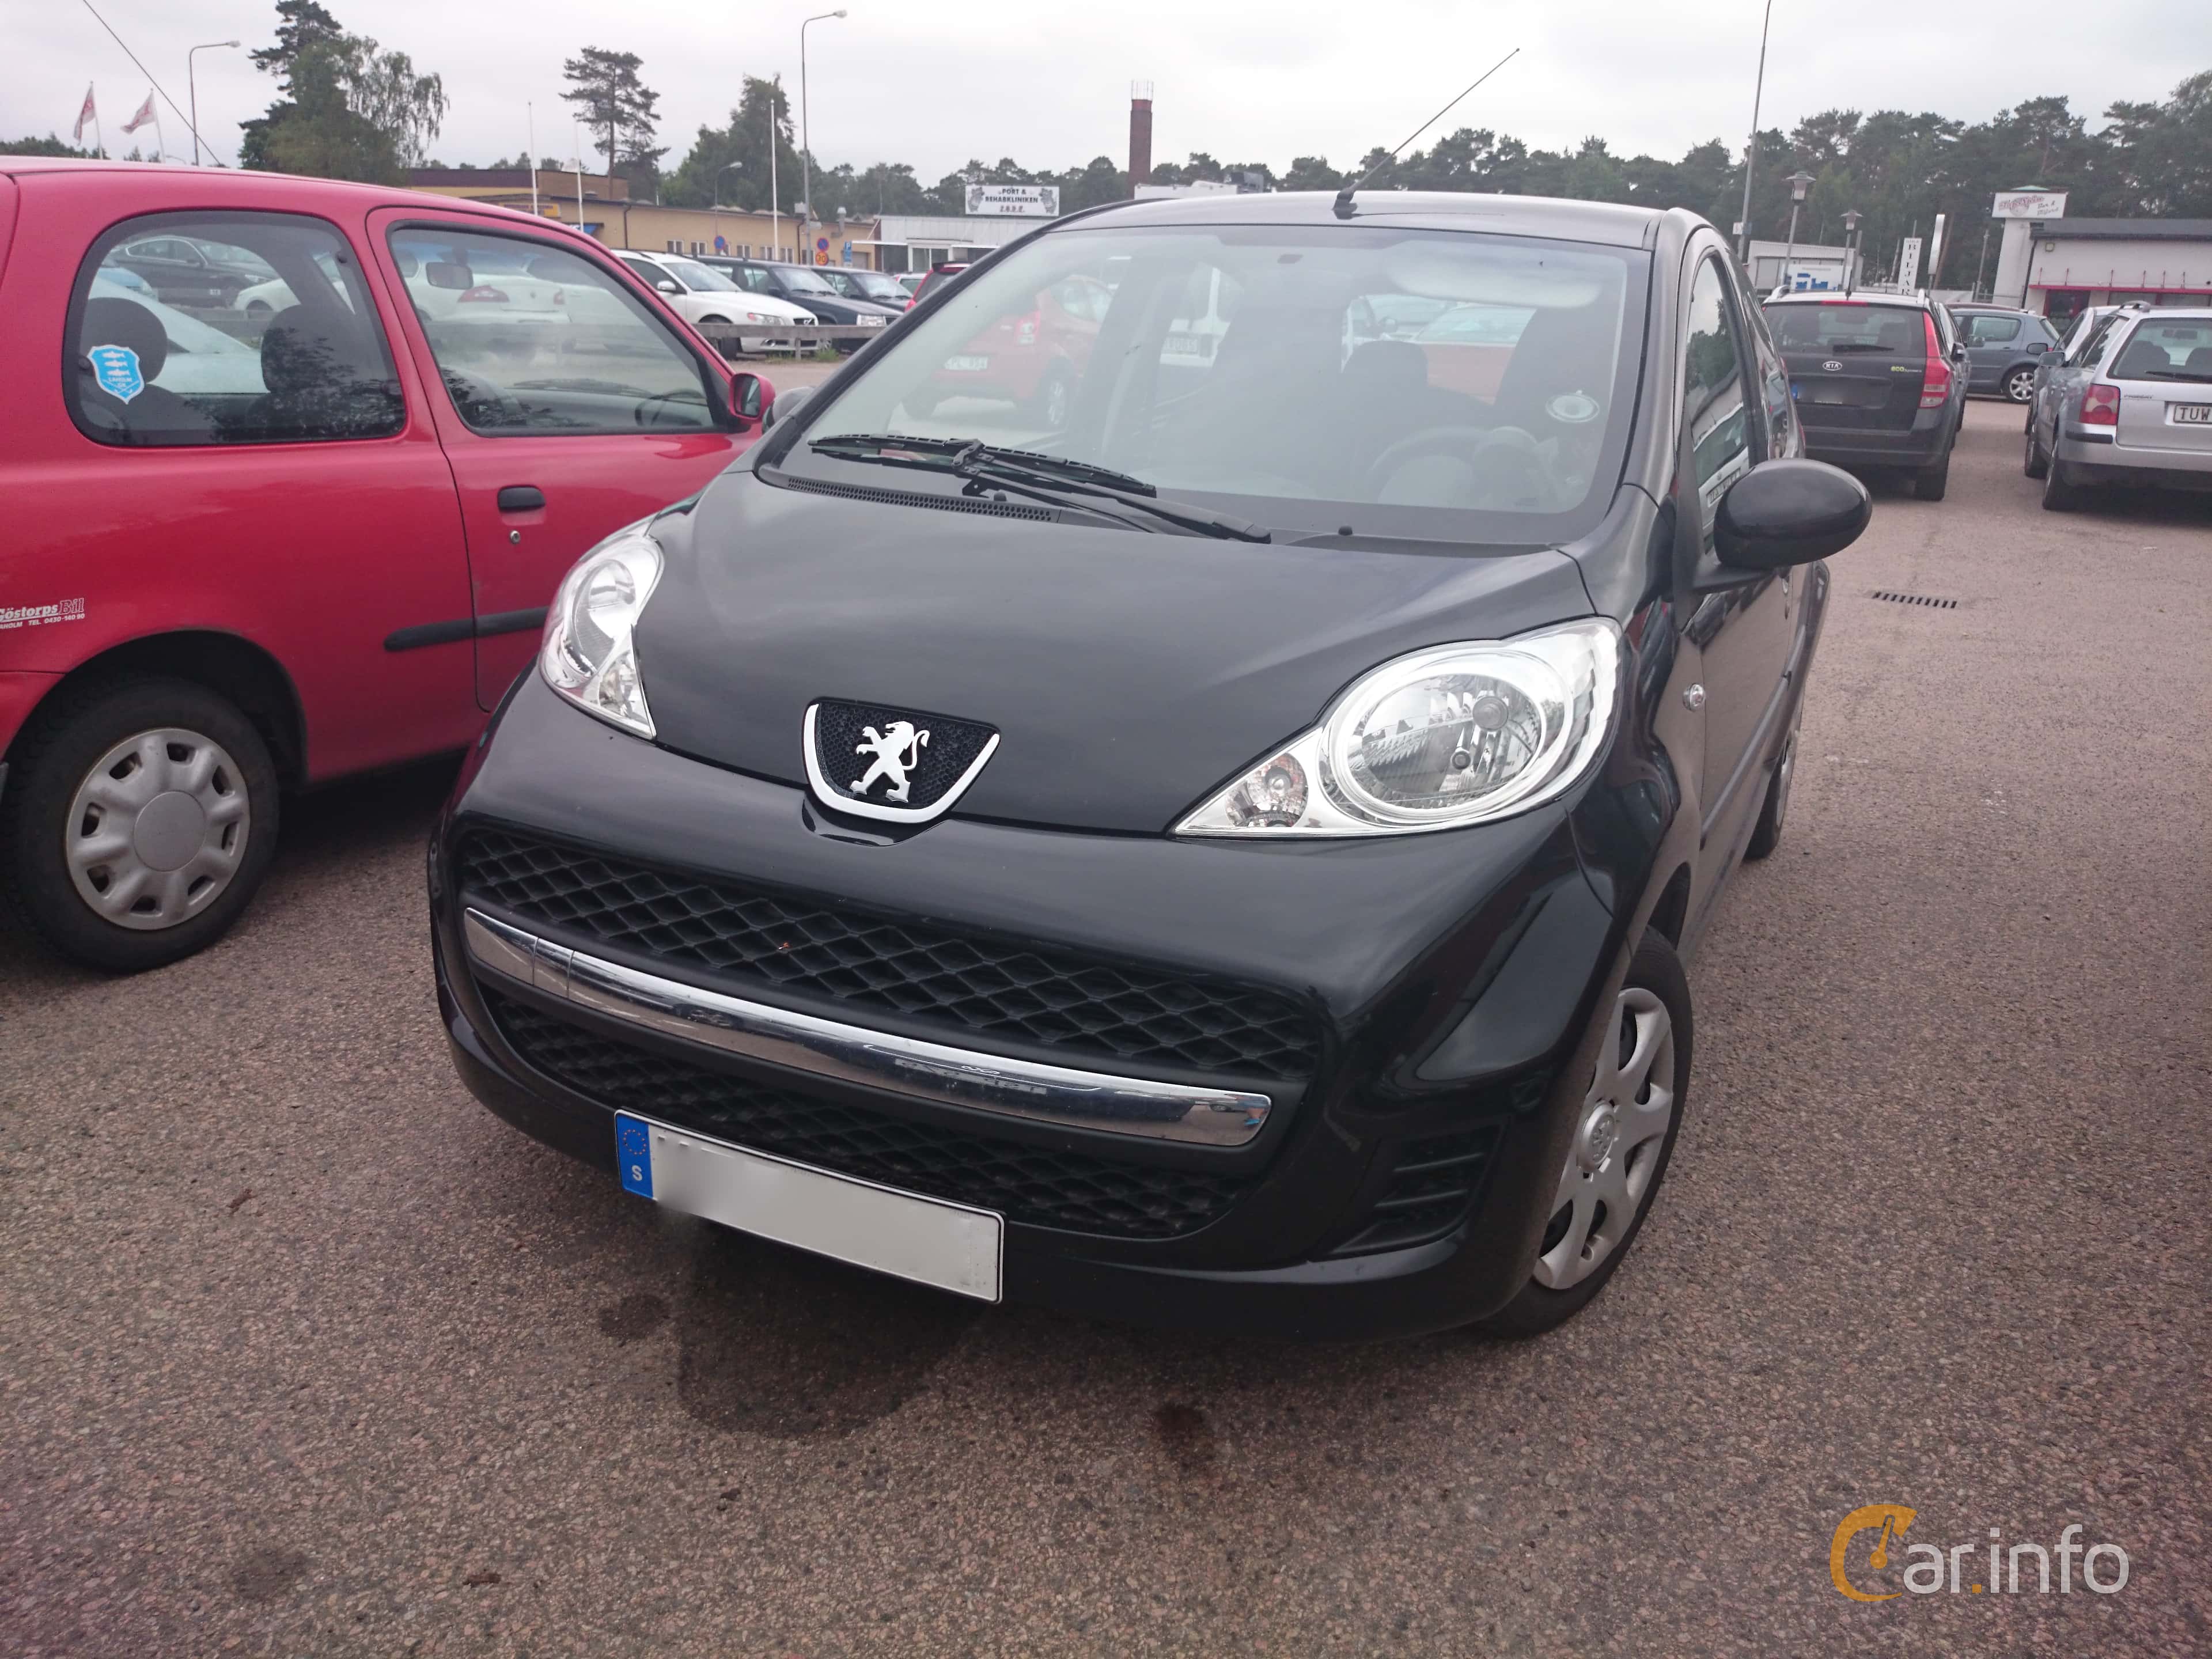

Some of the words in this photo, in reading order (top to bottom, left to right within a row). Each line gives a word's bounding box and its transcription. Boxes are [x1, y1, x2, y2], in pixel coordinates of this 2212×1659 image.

[2180, 407, 2211, 421] TUW
[59, 598, 84, 615] Bil
[631, 1165, 642, 1181] S
